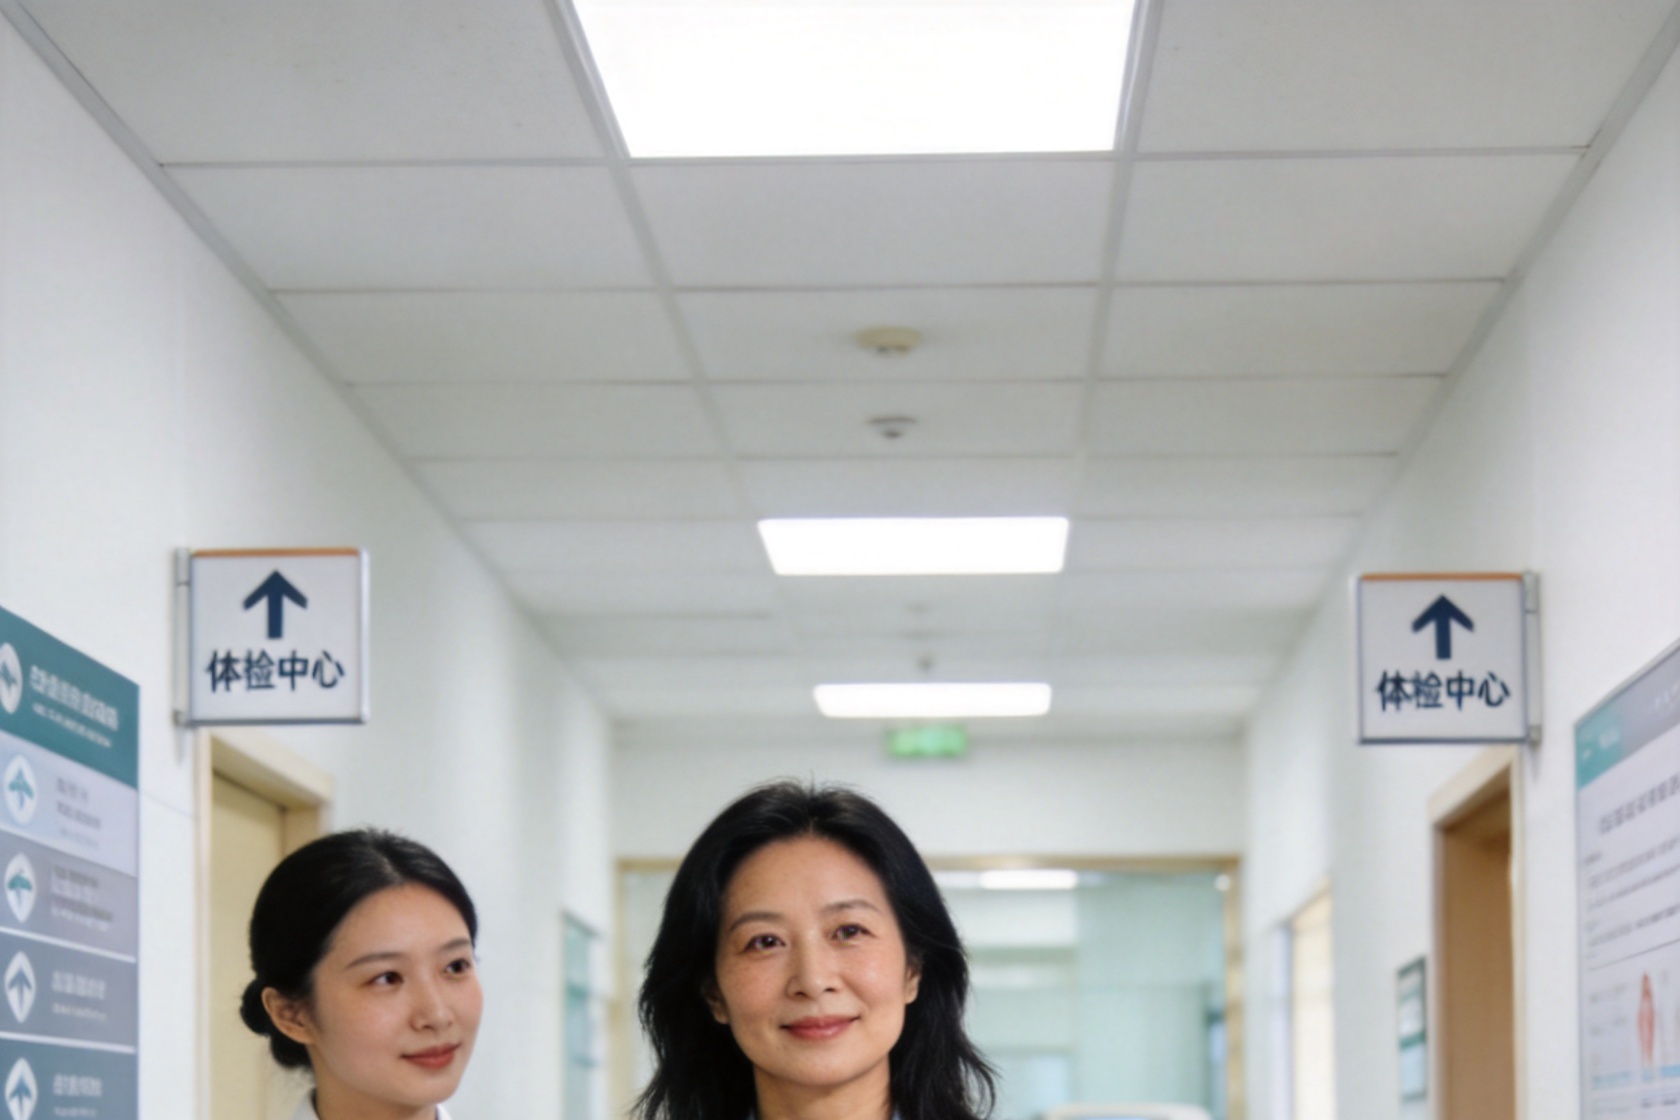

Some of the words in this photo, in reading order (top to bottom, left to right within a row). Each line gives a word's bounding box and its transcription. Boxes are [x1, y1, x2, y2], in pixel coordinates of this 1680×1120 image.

[206, 649, 345, 693] 体检中心
[1376, 670, 1511, 712] 体检中心
